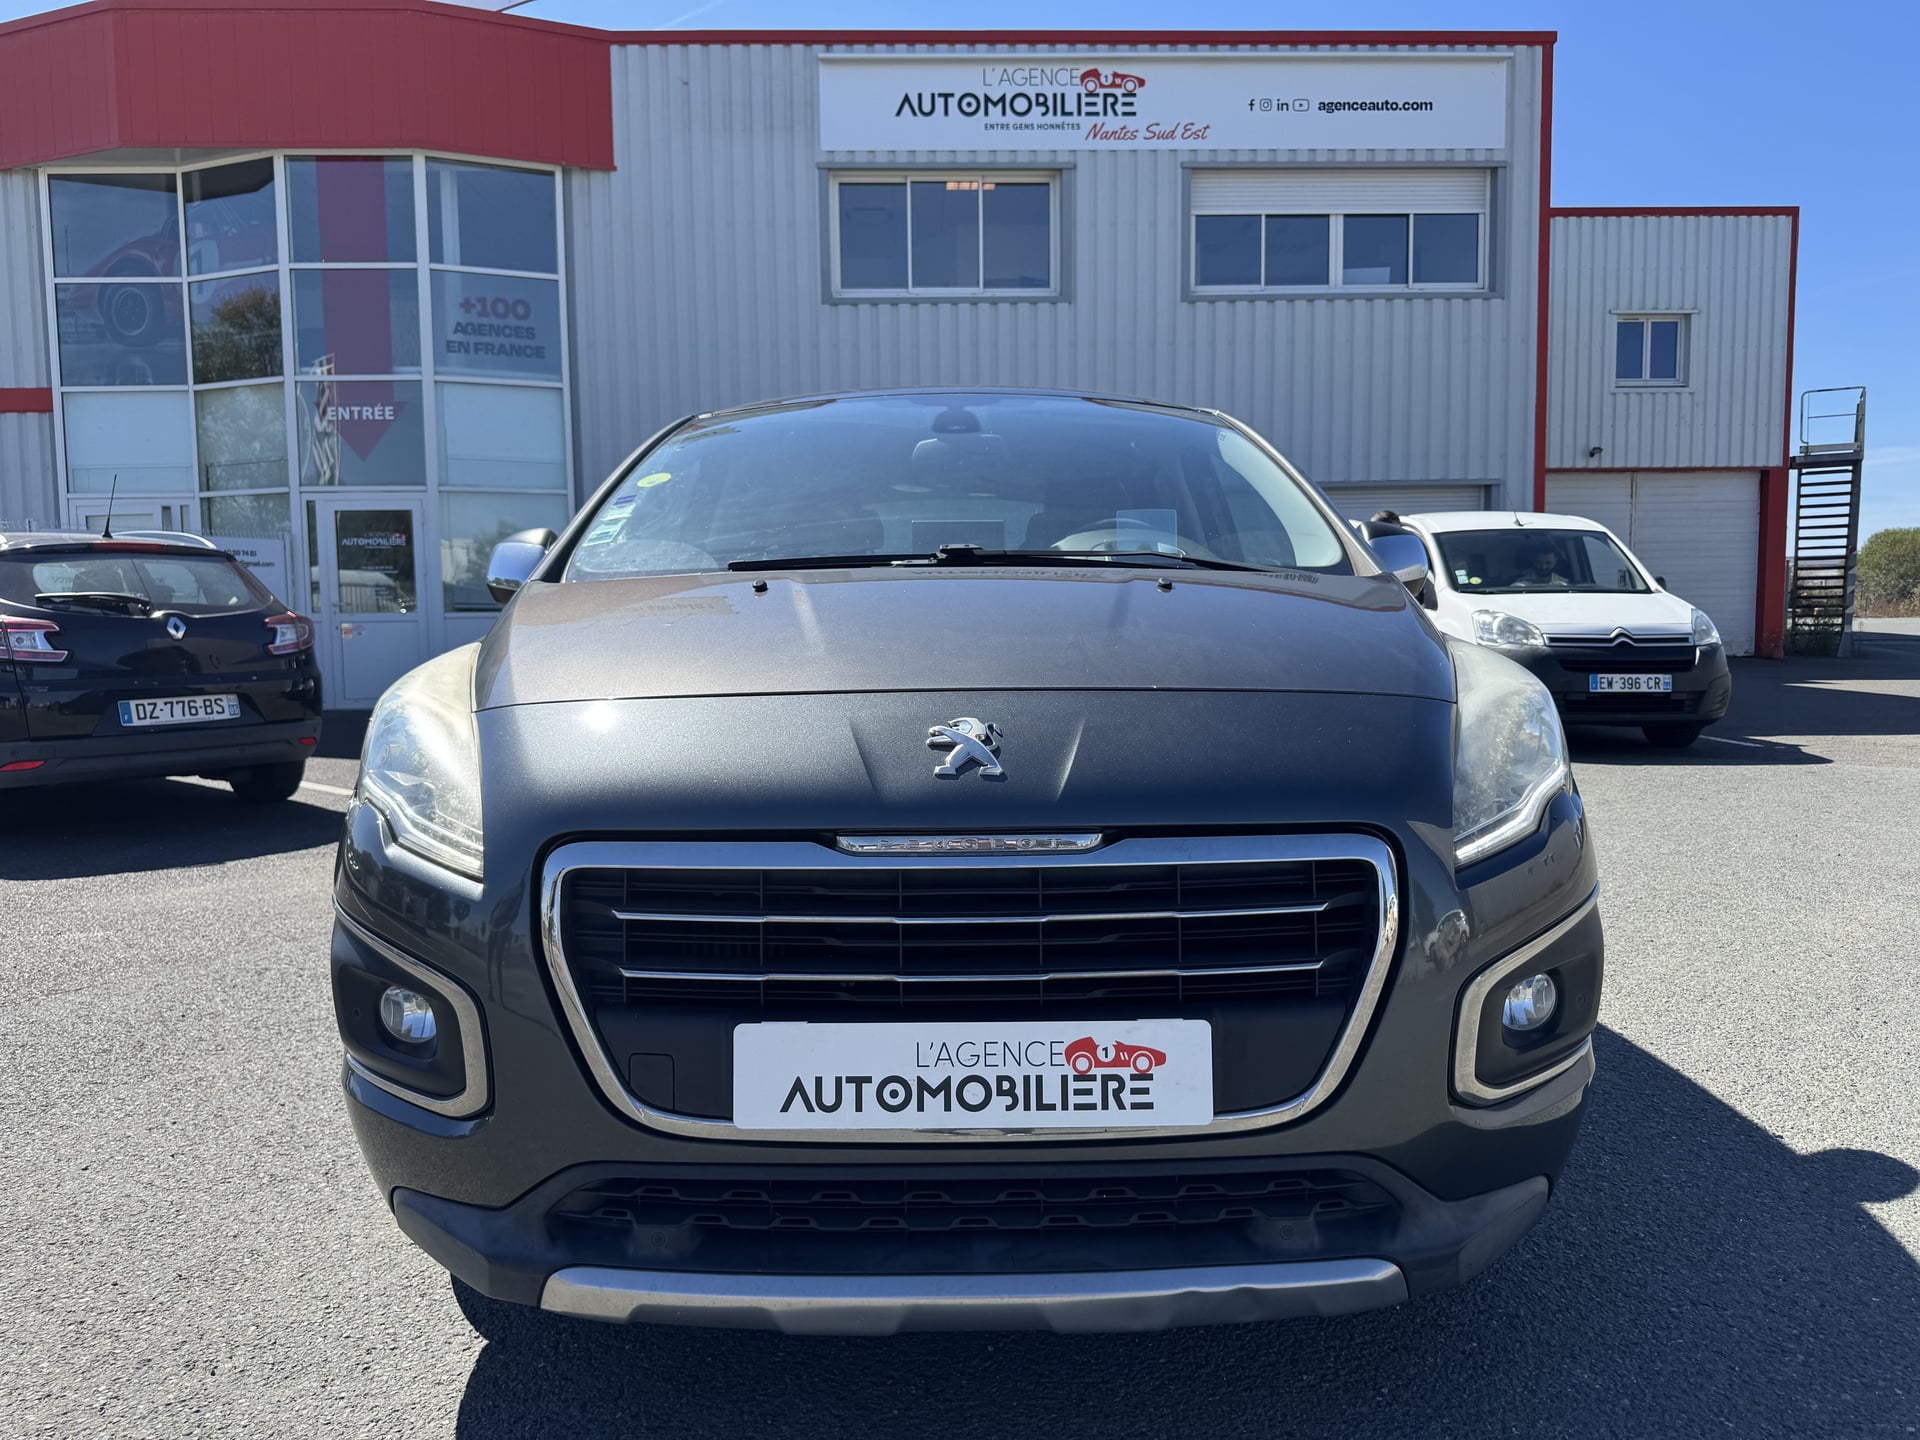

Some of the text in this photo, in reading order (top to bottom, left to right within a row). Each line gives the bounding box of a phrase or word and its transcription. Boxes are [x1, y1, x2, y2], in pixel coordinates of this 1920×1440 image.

[982, 67, 1080, 87] L'AGENCE
[1317, 99, 1434, 114] agenceauto.com
[984, 121, 1081, 131] ENTRE GENS HONNÊTES
[1085, 122, 1212, 141] Nantes Sud Est
[458, 297, 531, 321] +100
[453, 321, 537, 340] AGENCES
[446, 340, 546, 359] EN FRANCE
[327, 402, 395, 421] ENTRÉE
[1599, 676, 1662, 690] EW-396-CR
[135, 698, 225, 721] DZ-776-BS
[877, 838, 1063, 850] PEUGEOT
[916, 1040, 1066, 1068] L'AGENCE
